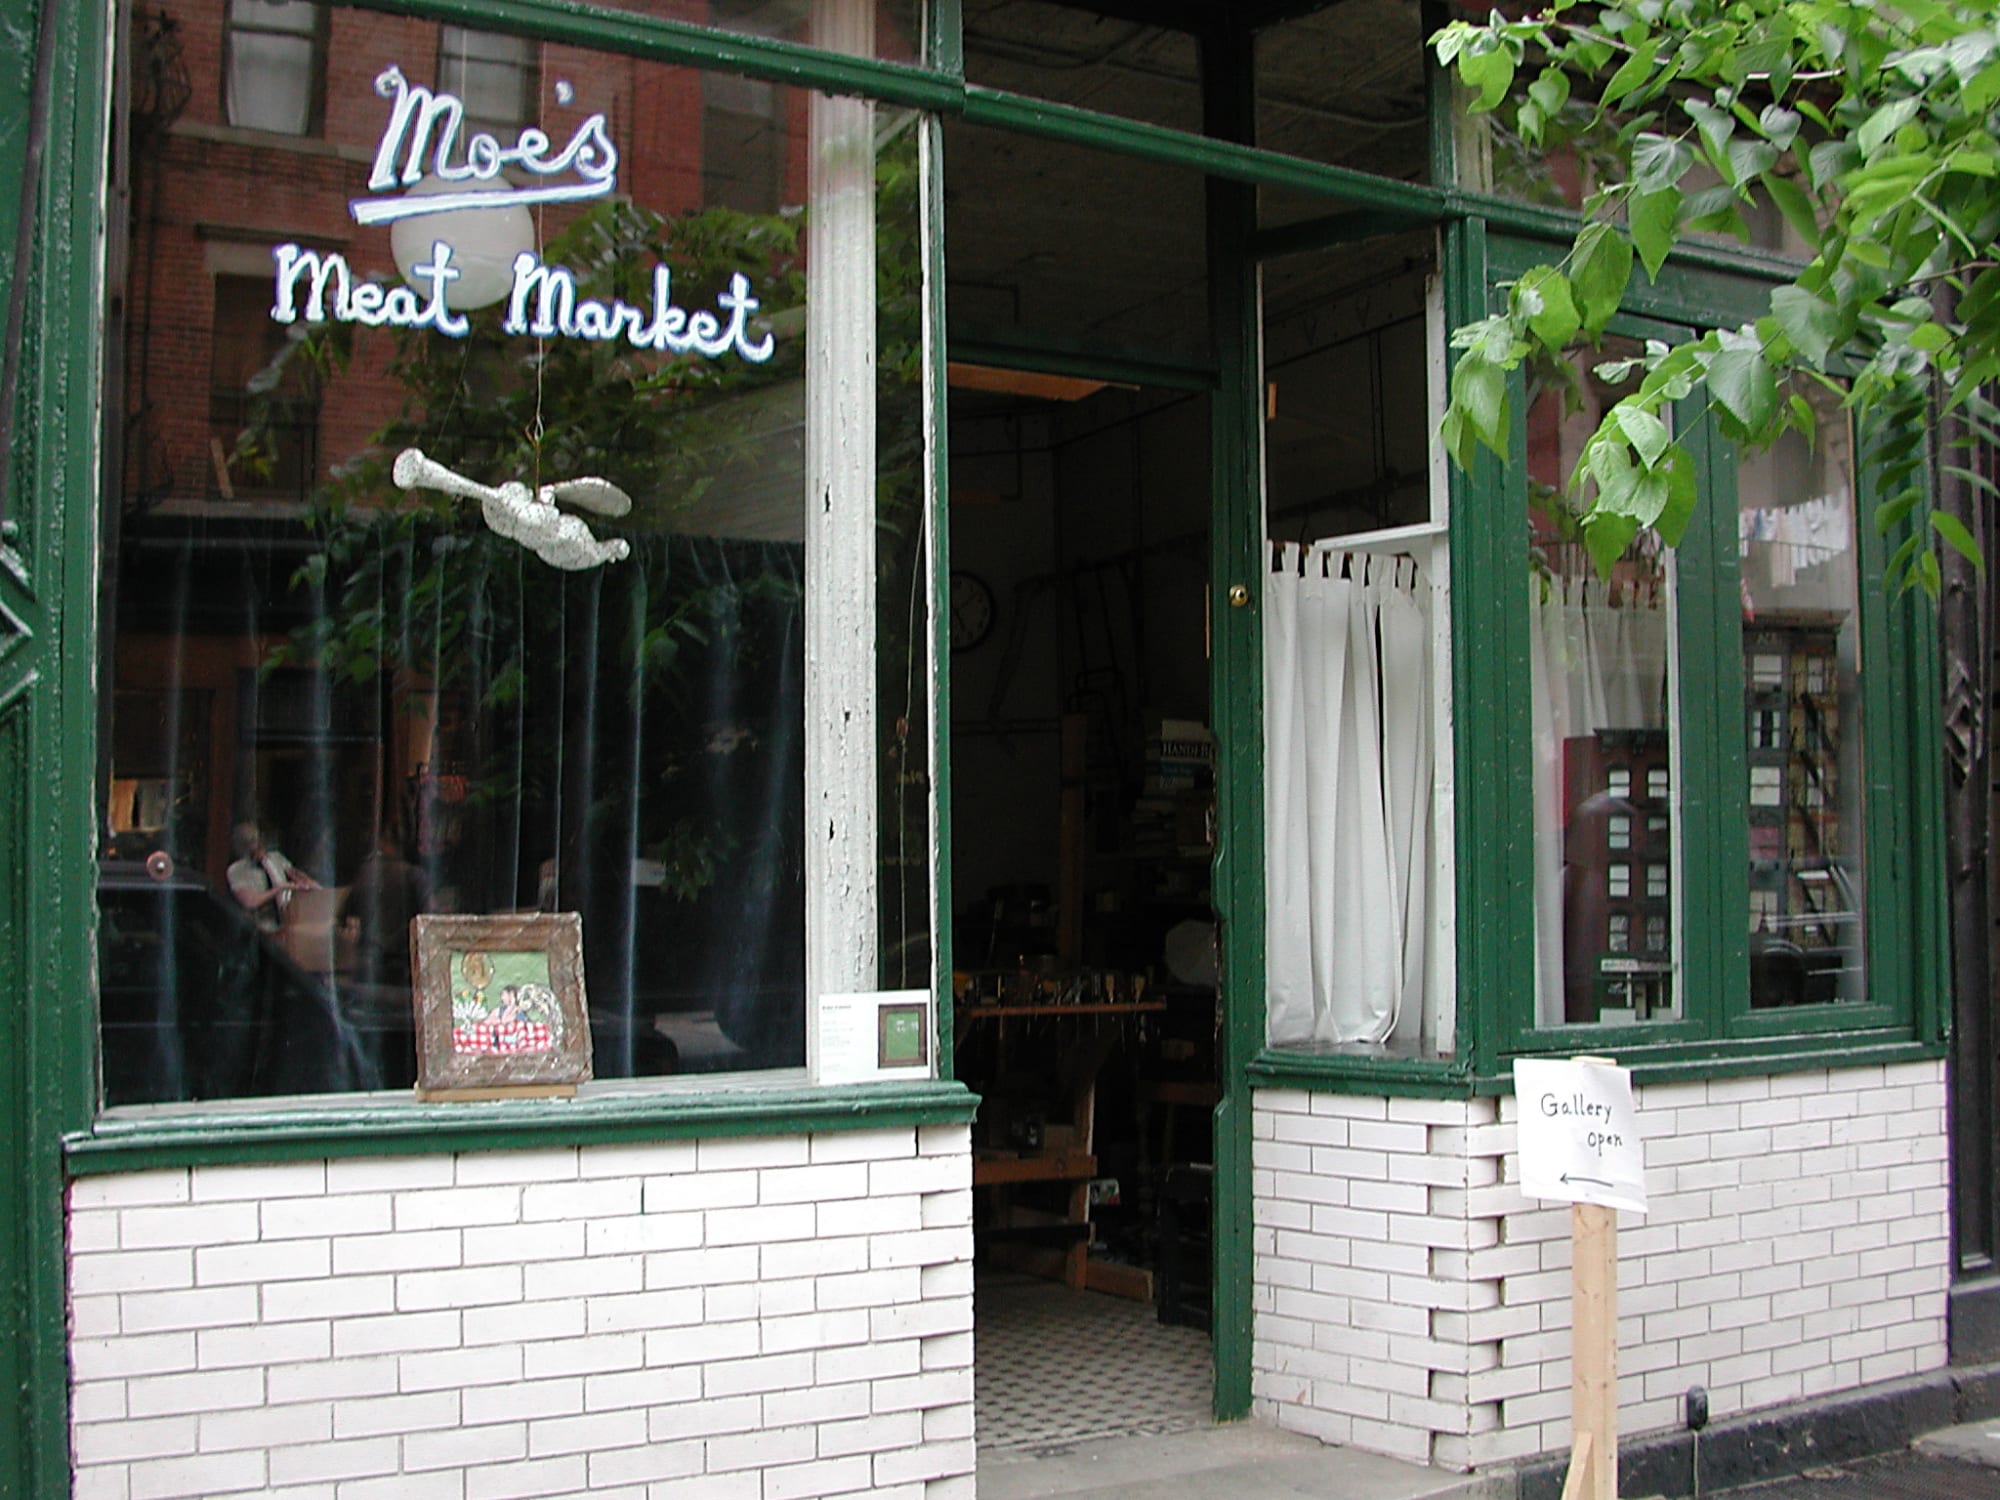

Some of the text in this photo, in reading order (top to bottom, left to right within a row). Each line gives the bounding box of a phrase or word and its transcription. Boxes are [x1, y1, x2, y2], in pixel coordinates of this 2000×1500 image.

[366, 64, 618, 192] Moe's
[272, 242, 774, 362] Meat Market
[1540, 1092, 1612, 1125] Gallery
